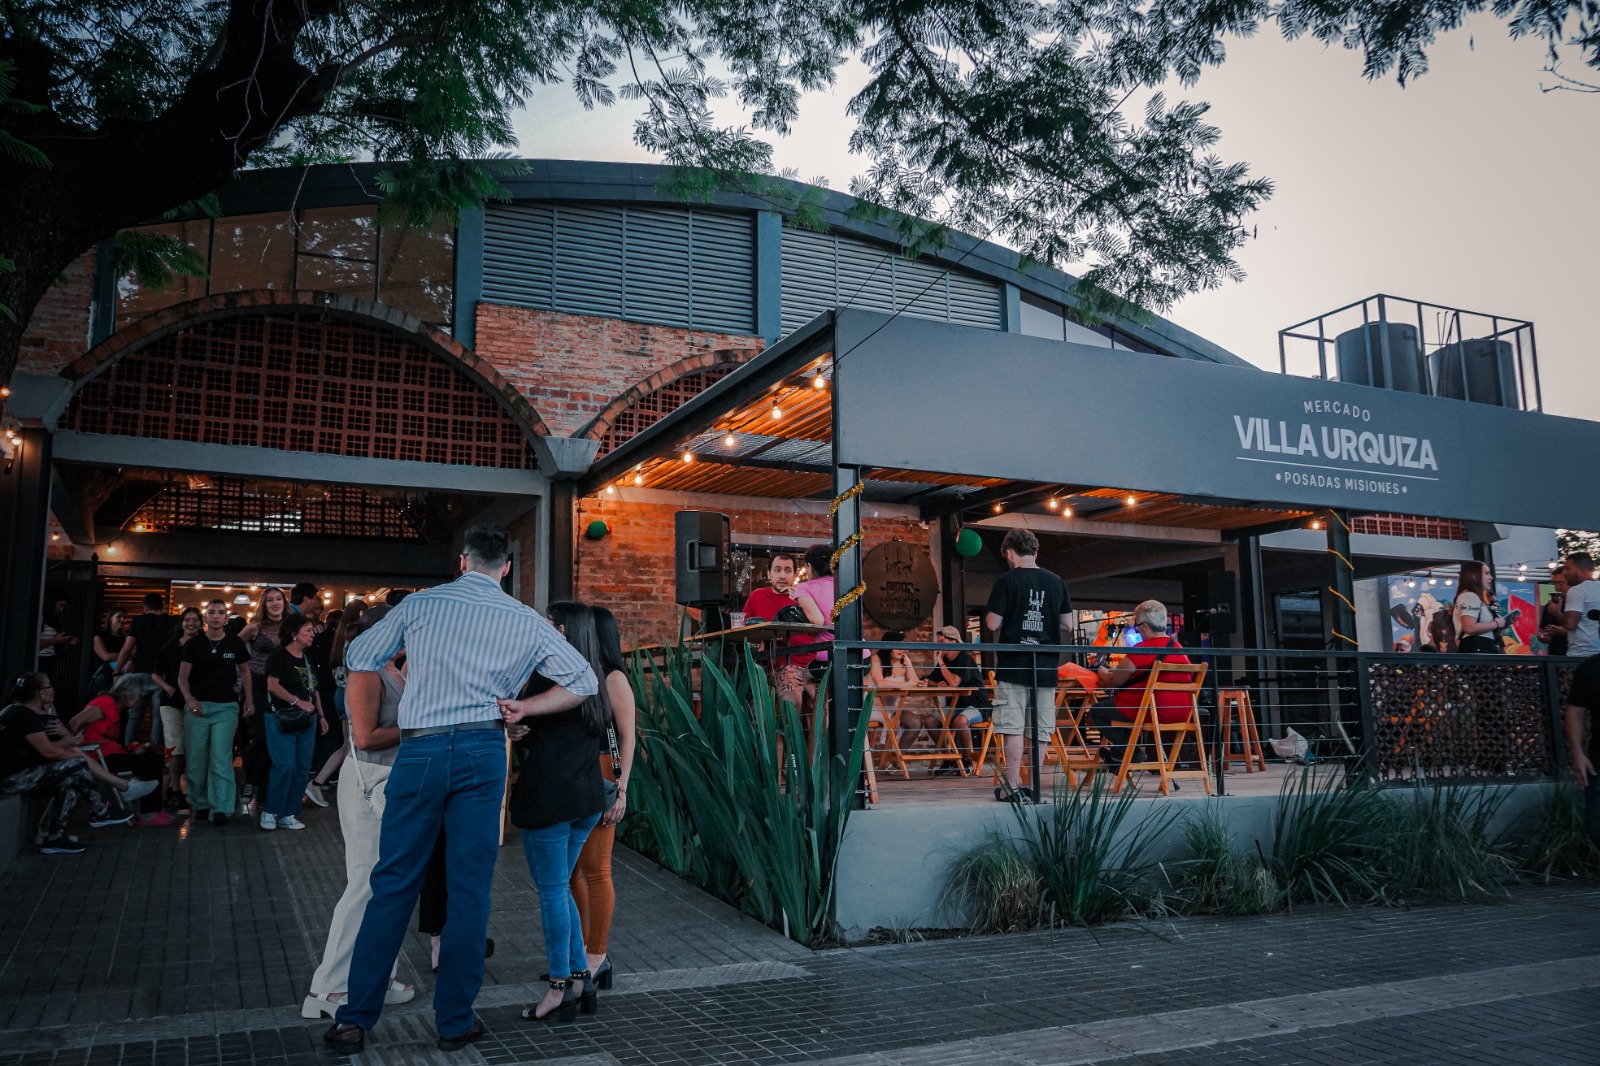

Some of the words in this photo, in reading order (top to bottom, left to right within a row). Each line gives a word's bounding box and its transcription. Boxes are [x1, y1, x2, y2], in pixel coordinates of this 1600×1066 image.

[1303, 400, 1371, 422] MERCADO
[1233, 415, 1319, 458] VILLA
[1321, 426, 1438, 471] URQUIZA
[1284, 471, 1341, 489] POSADAS
[1345, 478, 1400, 495] MISIONES
